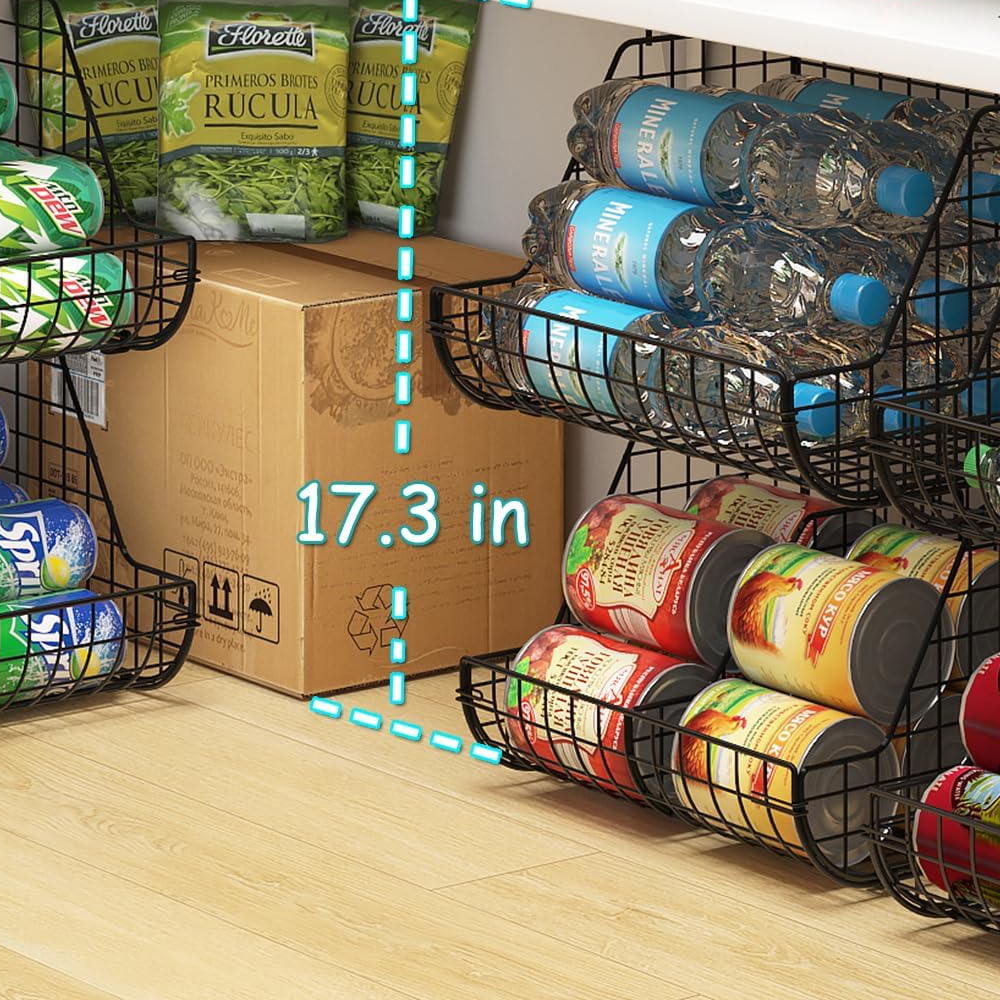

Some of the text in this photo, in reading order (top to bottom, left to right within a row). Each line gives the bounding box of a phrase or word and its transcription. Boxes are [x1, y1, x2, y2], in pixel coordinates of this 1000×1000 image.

[80, 9, 153, 40] Florette
[217, 22, 308, 49] Florette
[204, 72, 318, 88] PRIMEROS BROTES
[204, 90, 318, 120] RÚCULA
[240, 131, 271, 143] Exquisito
[817, 570, 872, 639] МЯСО КУР
[777, 708, 817, 742] МЯСО
